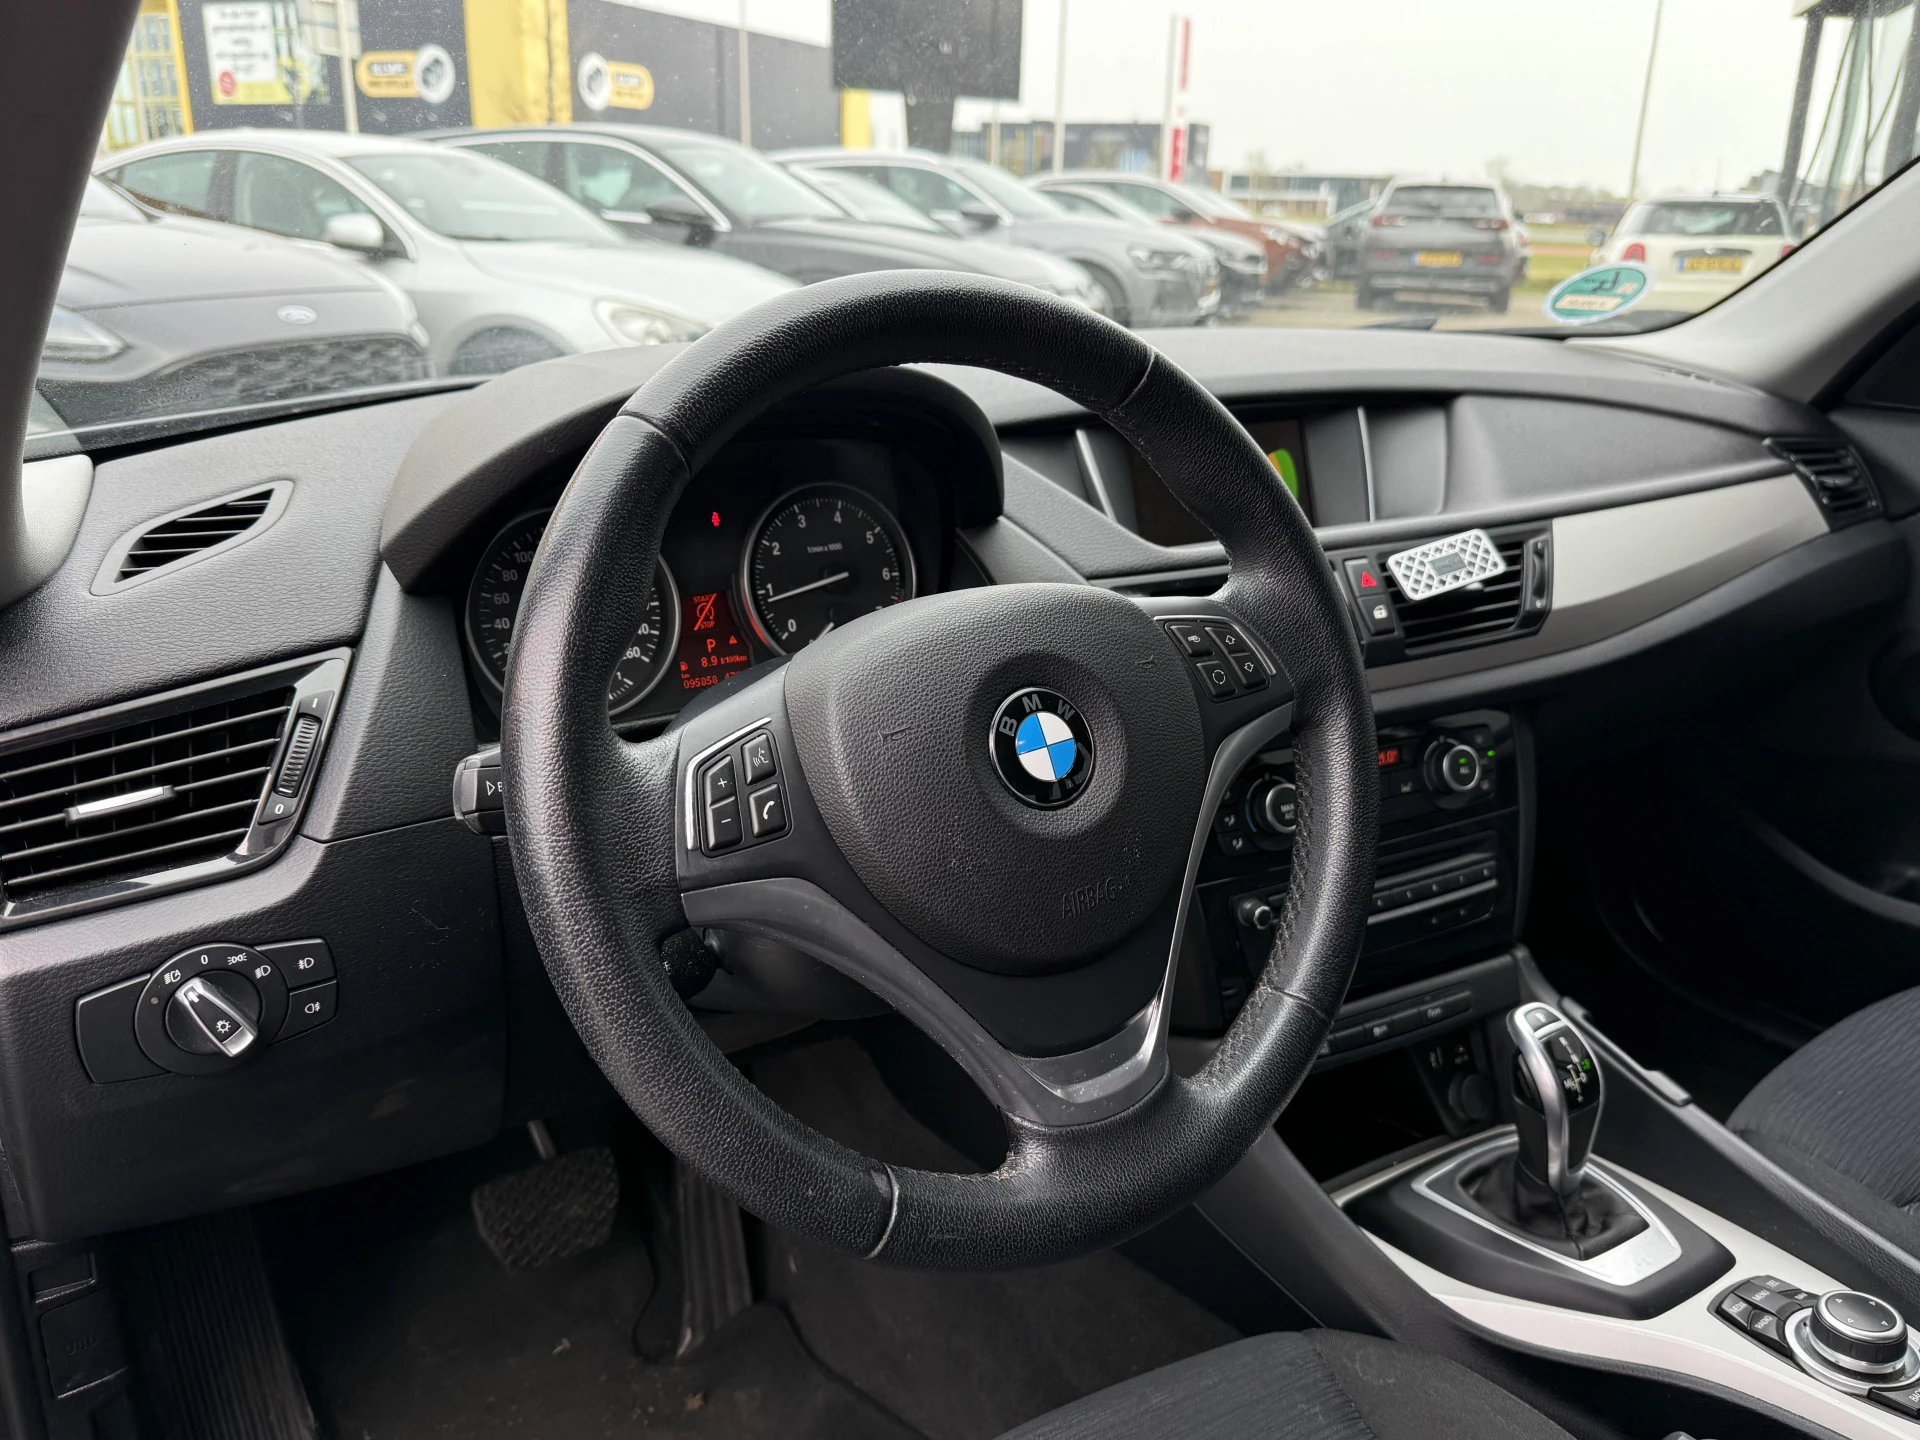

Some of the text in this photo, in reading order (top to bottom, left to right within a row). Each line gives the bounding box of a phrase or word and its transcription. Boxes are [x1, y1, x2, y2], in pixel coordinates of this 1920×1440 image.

[797, 515, 806, 528] 3
[834, 510, 842, 524] 4
[866, 531, 874, 544] 5
[771, 542, 781, 555] 2
[502, 569, 518, 581] 80
[882, 567, 891, 581] 6
[766, 583, 773, 596] 1
[494, 592, 510, 604] 60
[494, 617, 510, 629] 40
[700, 621, 715, 629] STOP
[787, 619, 797, 632] 0
[706, 638, 716, 652] P
[701, 654, 718, 667] 8.9
[683, 675, 718, 689] 095858
[999, 693, 1076, 737] BMW
[1062, 877, 1116, 919] AIRBAG
[200, 954, 208, 965] 0
[1765, 1280, 1780, 1288] TEL
[1752, 1289, 1770, 1301] MENU
[1729, 1301, 1748, 1313] MEDIA
[1754, 1315, 1773, 1329] RADIO
